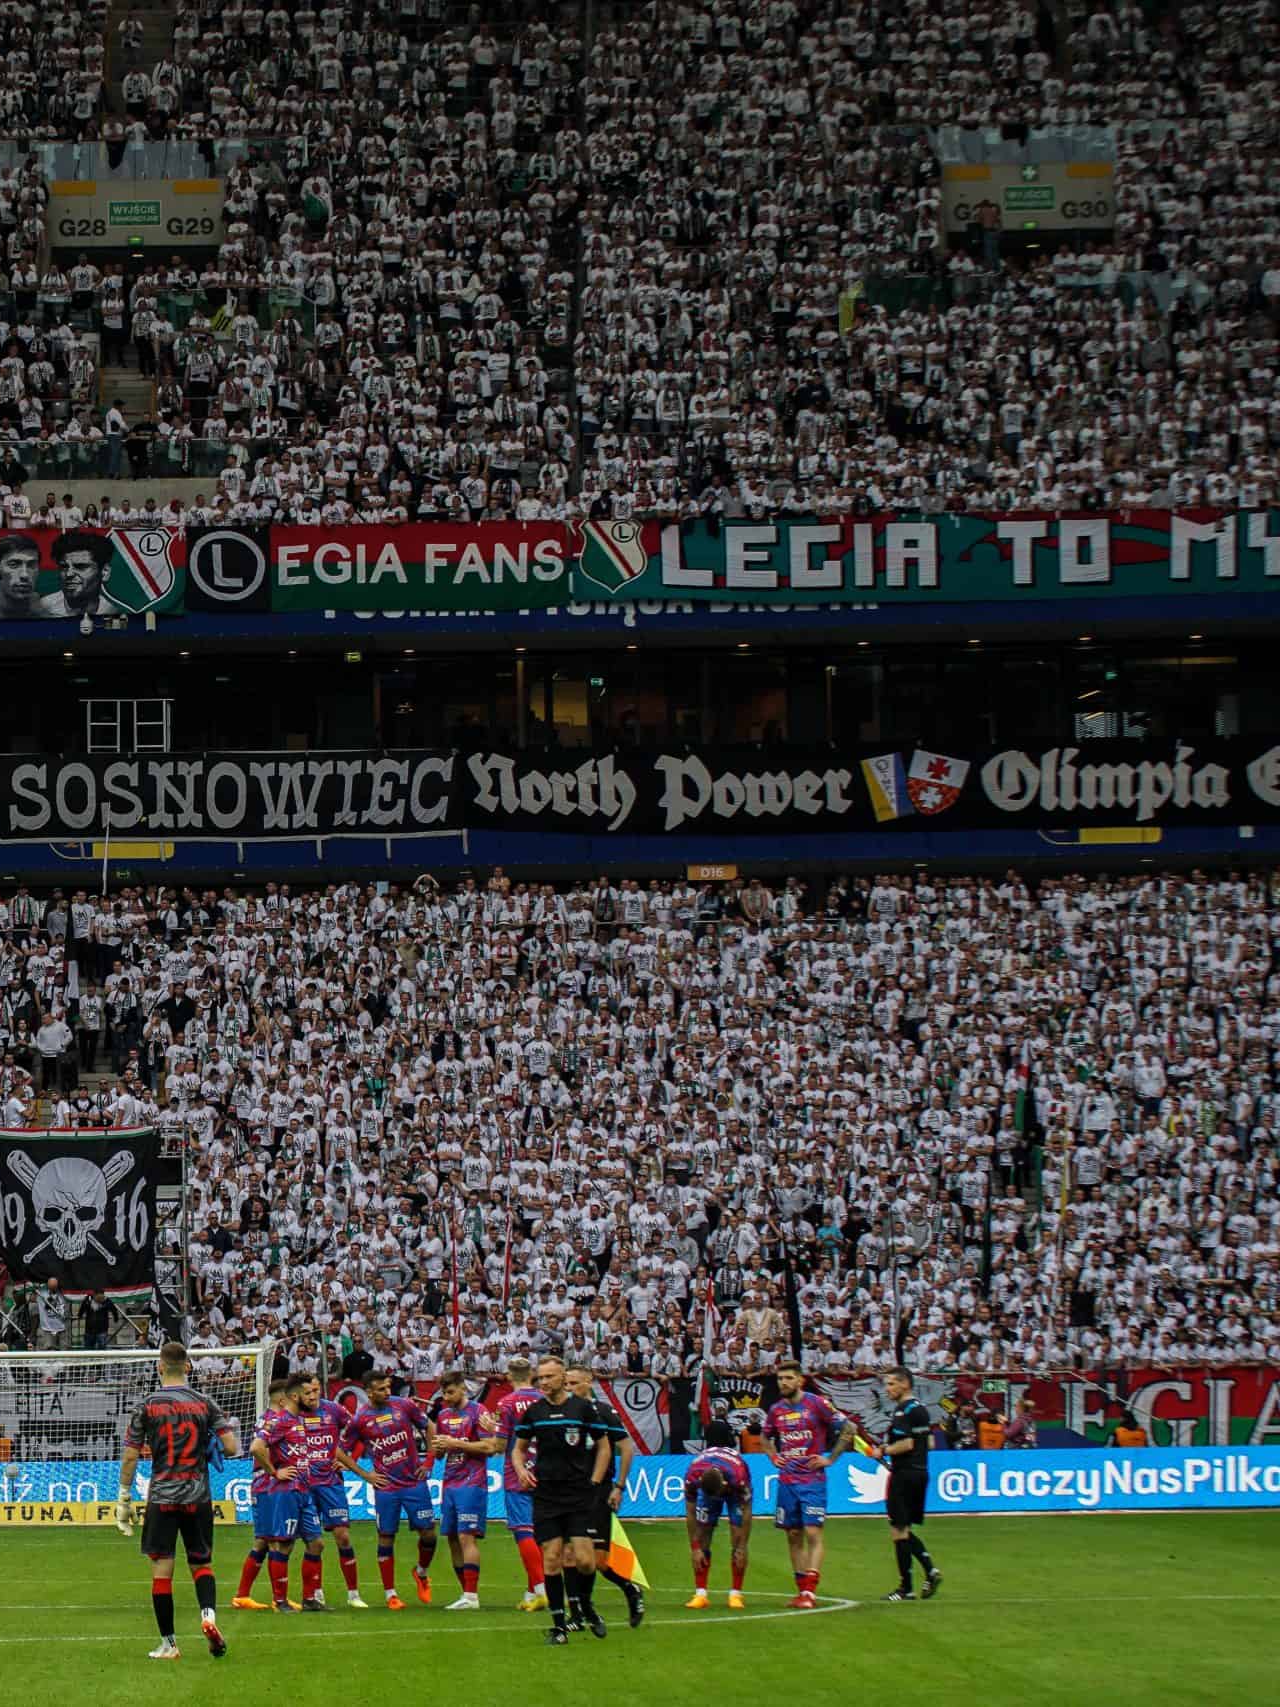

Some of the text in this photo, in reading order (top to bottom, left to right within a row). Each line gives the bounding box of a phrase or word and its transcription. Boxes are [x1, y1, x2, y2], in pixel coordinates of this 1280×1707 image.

[59, 219, 107, 237] G28
[167, 217, 214, 235] G29
[1061, 201, 1109, 219] G30
[425, 538, 564, 585] FANS
[661, 520, 939, 590] LEGIA
[997, 519, 1111, 584] TO
[10, 754, 456, 832] SOSNOWIEC
[468, 752, 853, 831] North Power
[158, 1420, 197, 1467] 12
[937, 1455, 1280, 1507] @LaczyNasPilka
[285, 1518, 298, 1536] 17
